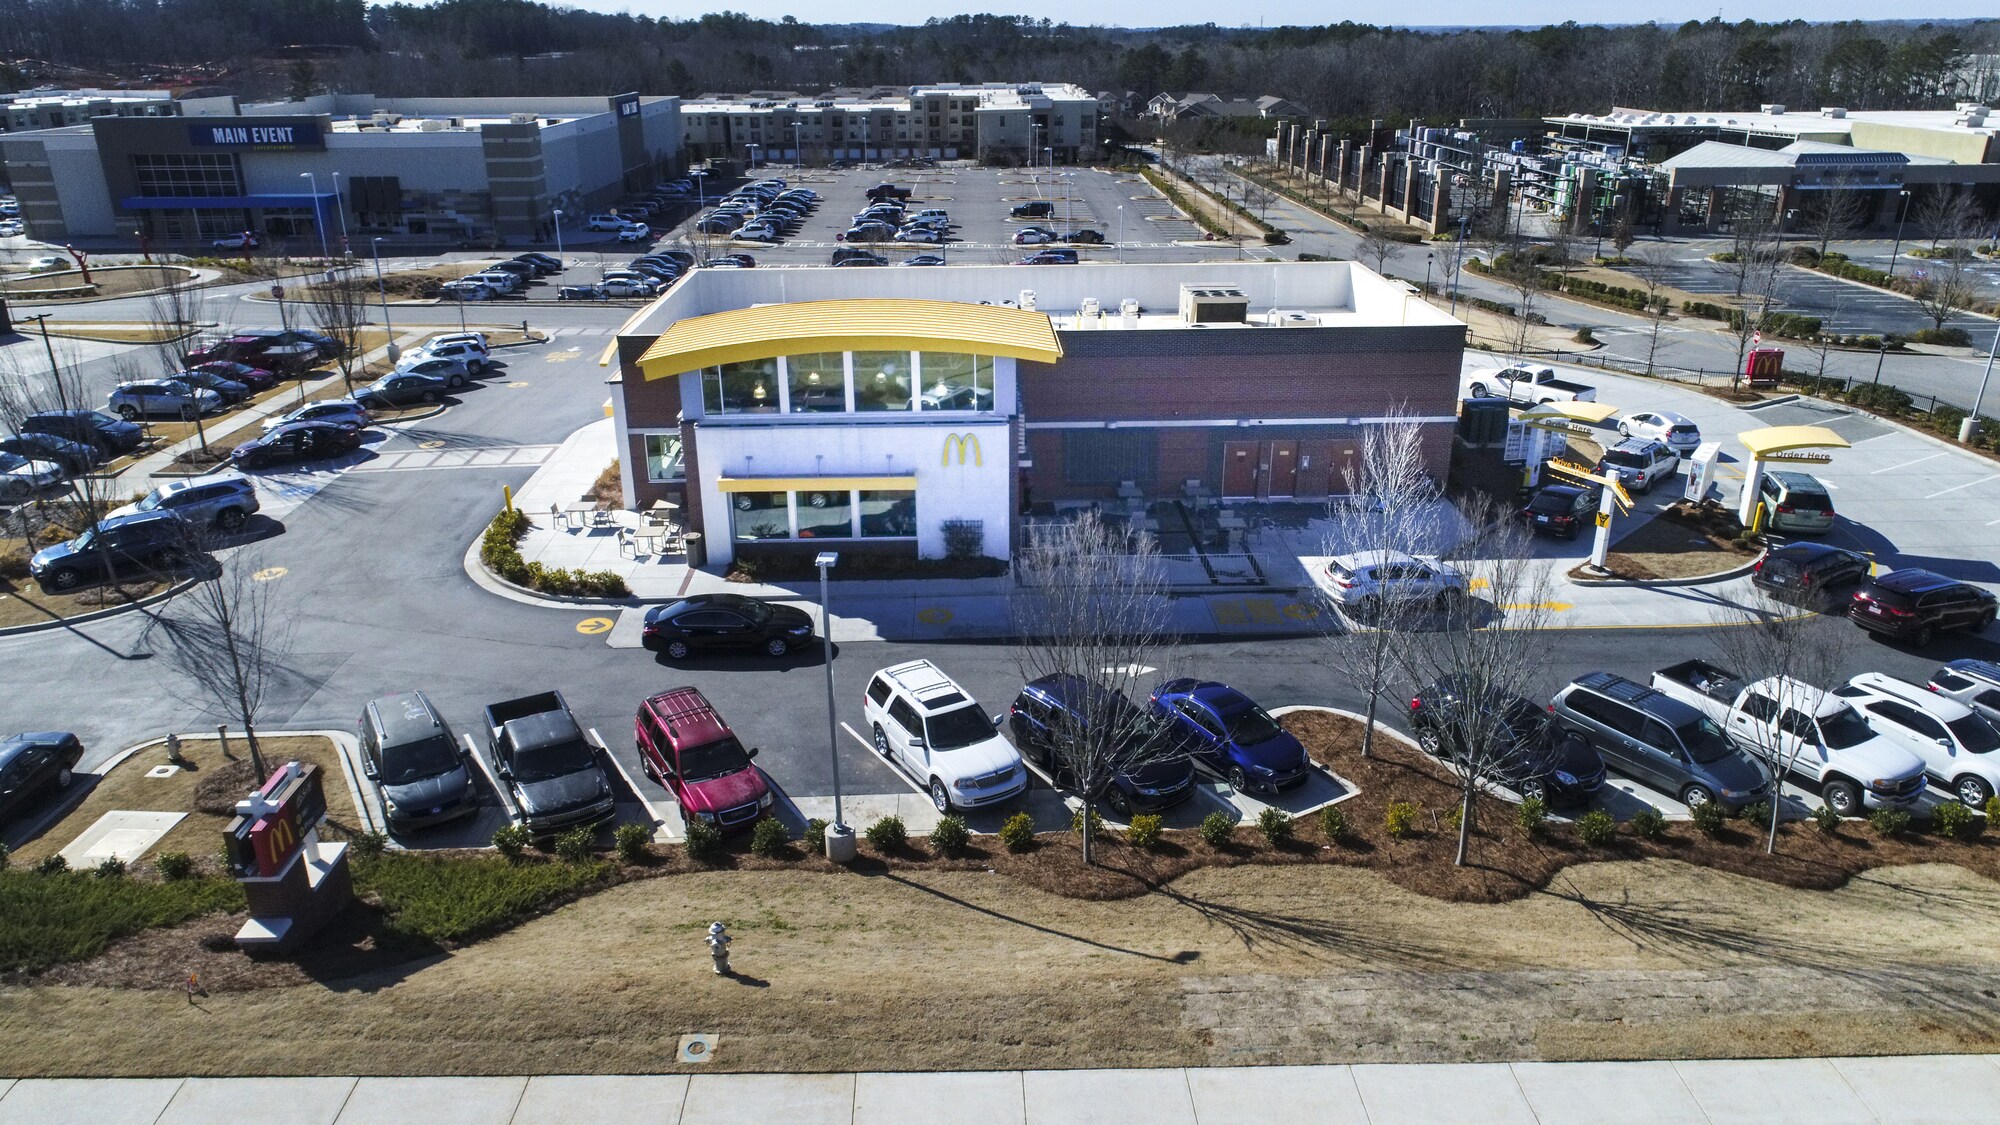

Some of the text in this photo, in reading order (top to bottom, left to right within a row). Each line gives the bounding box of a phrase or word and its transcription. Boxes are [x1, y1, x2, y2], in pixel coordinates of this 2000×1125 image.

[212, 127, 293, 143] MAIN EVENT
[1545, 419, 1592, 433] Order Here
[1776, 450, 1831, 460] Order Here
[1552, 456, 1572, 467] Drive
[1573, 462, 1591, 474] Thru
